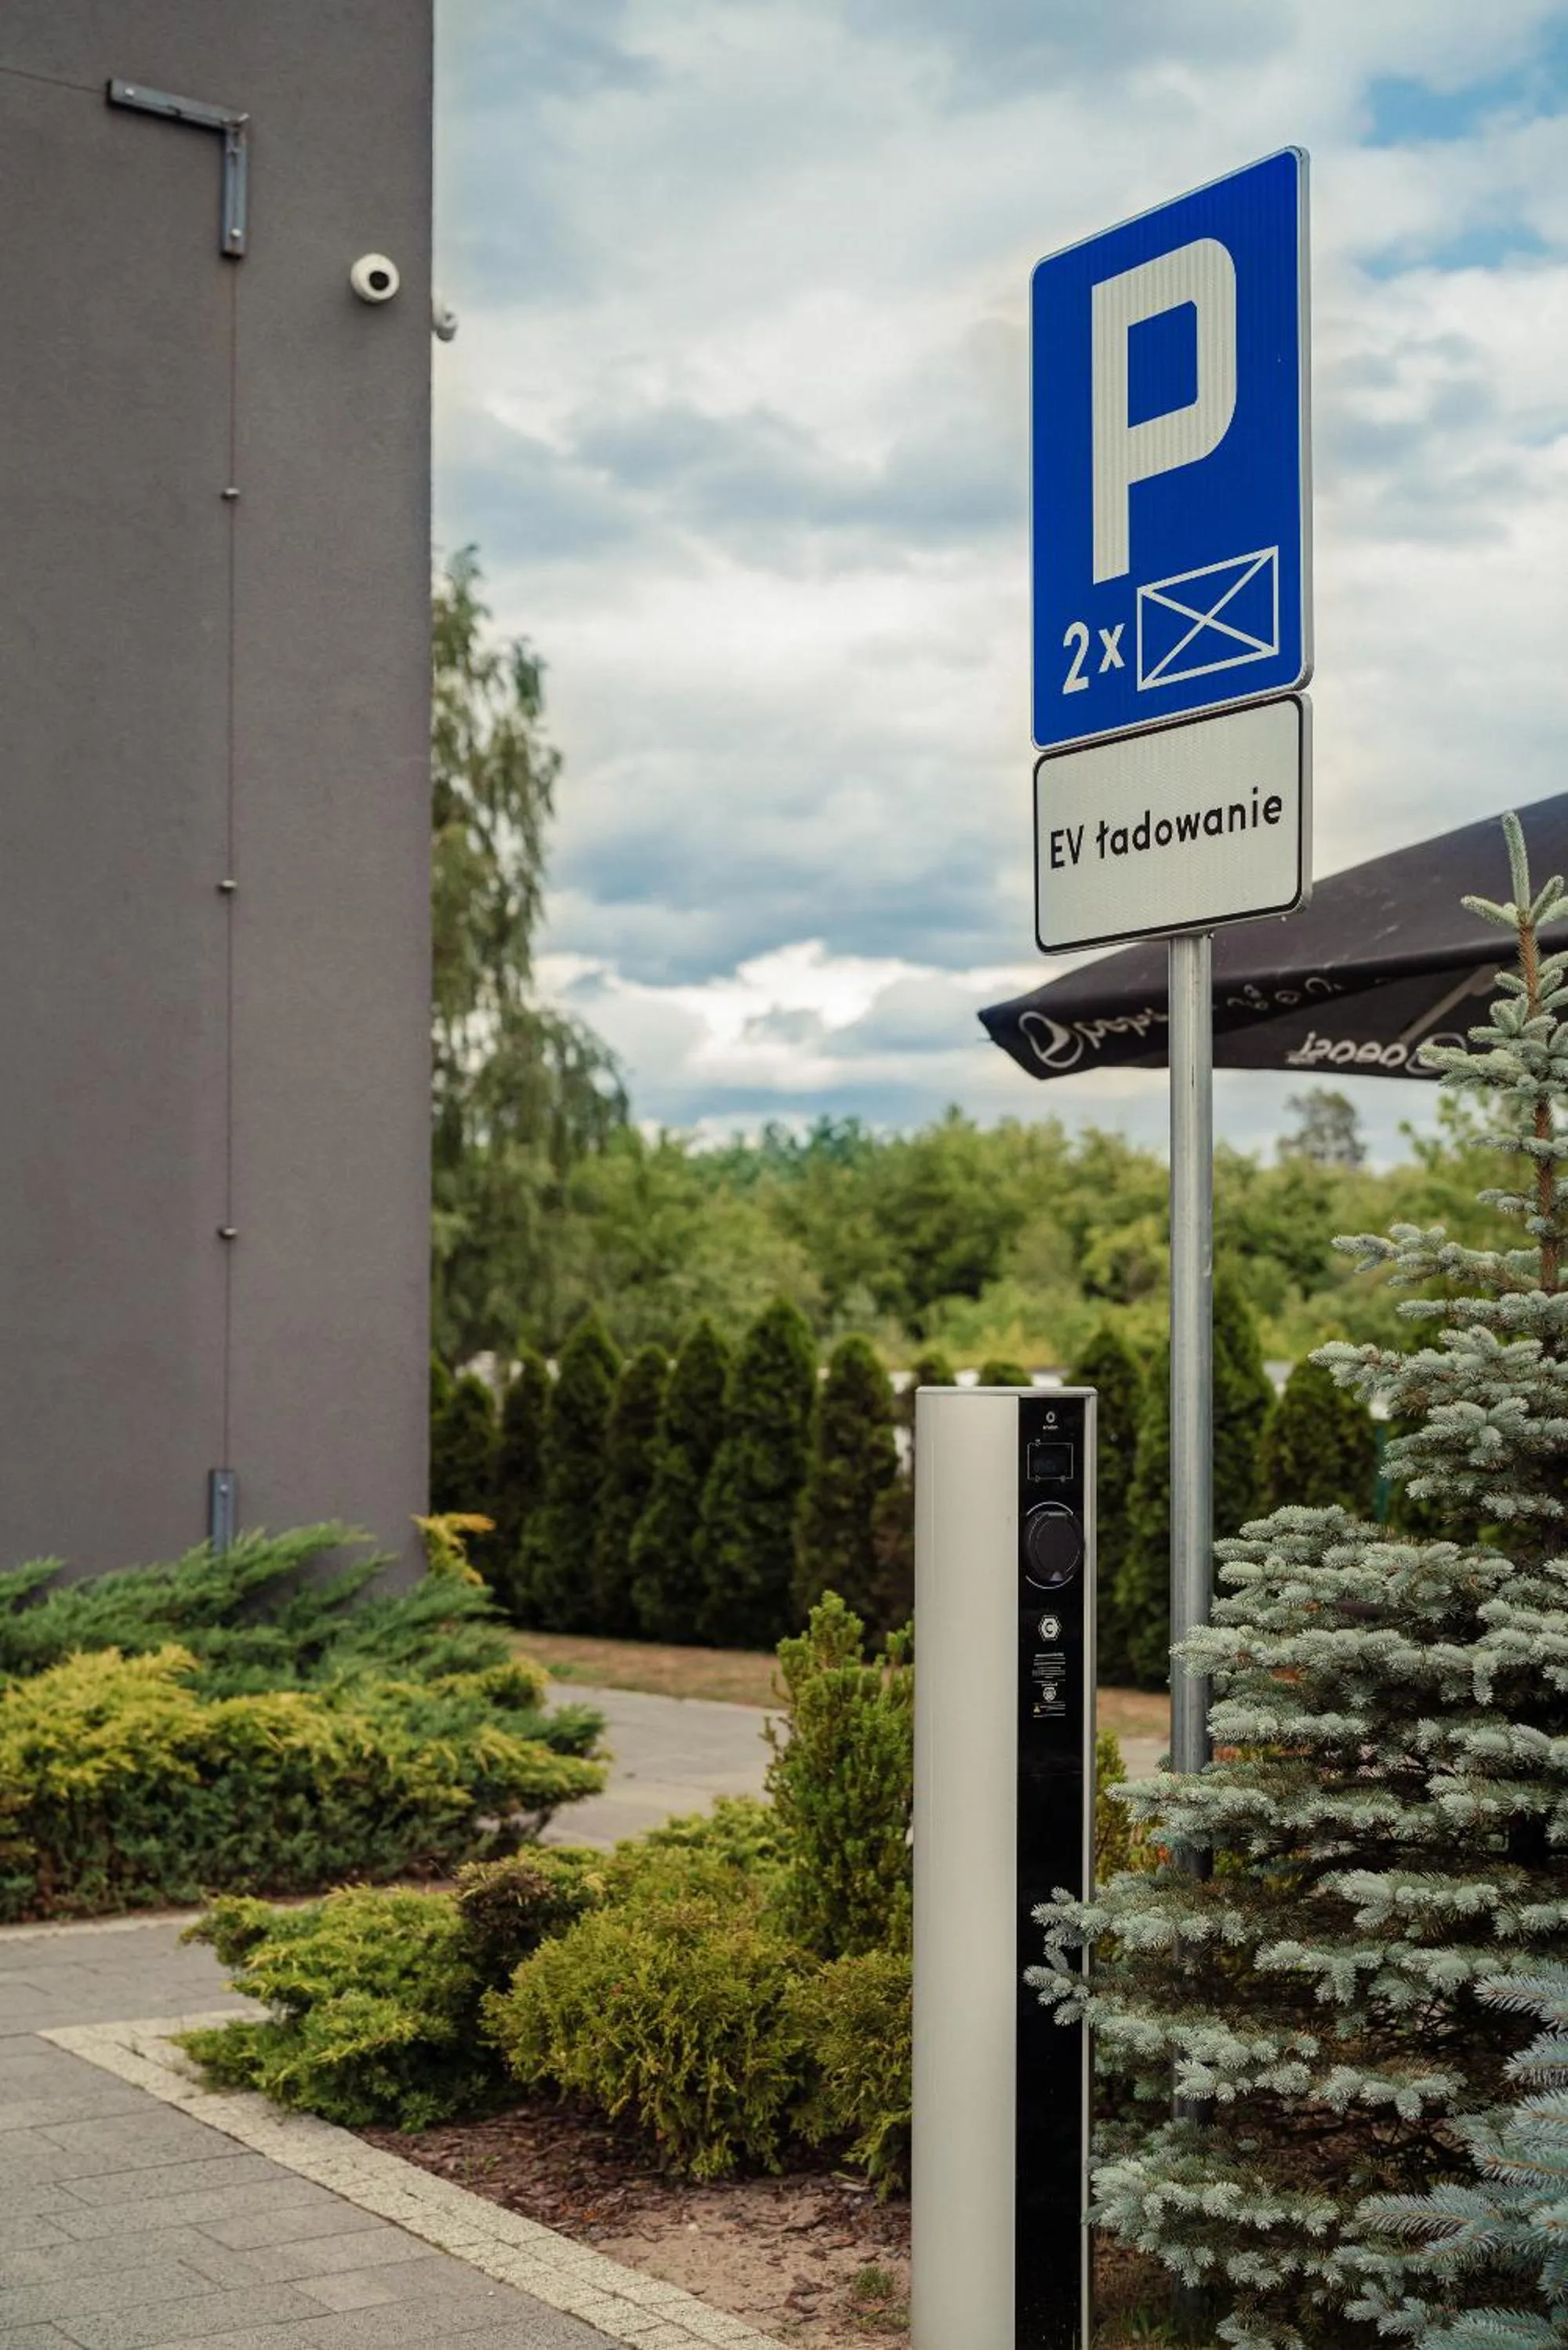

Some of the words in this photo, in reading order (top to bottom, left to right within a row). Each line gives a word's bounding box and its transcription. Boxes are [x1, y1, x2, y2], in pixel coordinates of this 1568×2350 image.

[1092, 238, 1236, 585] P
[1051, 825, 1084, 869] EV
[1096, 786, 1283, 859] ładowanie
